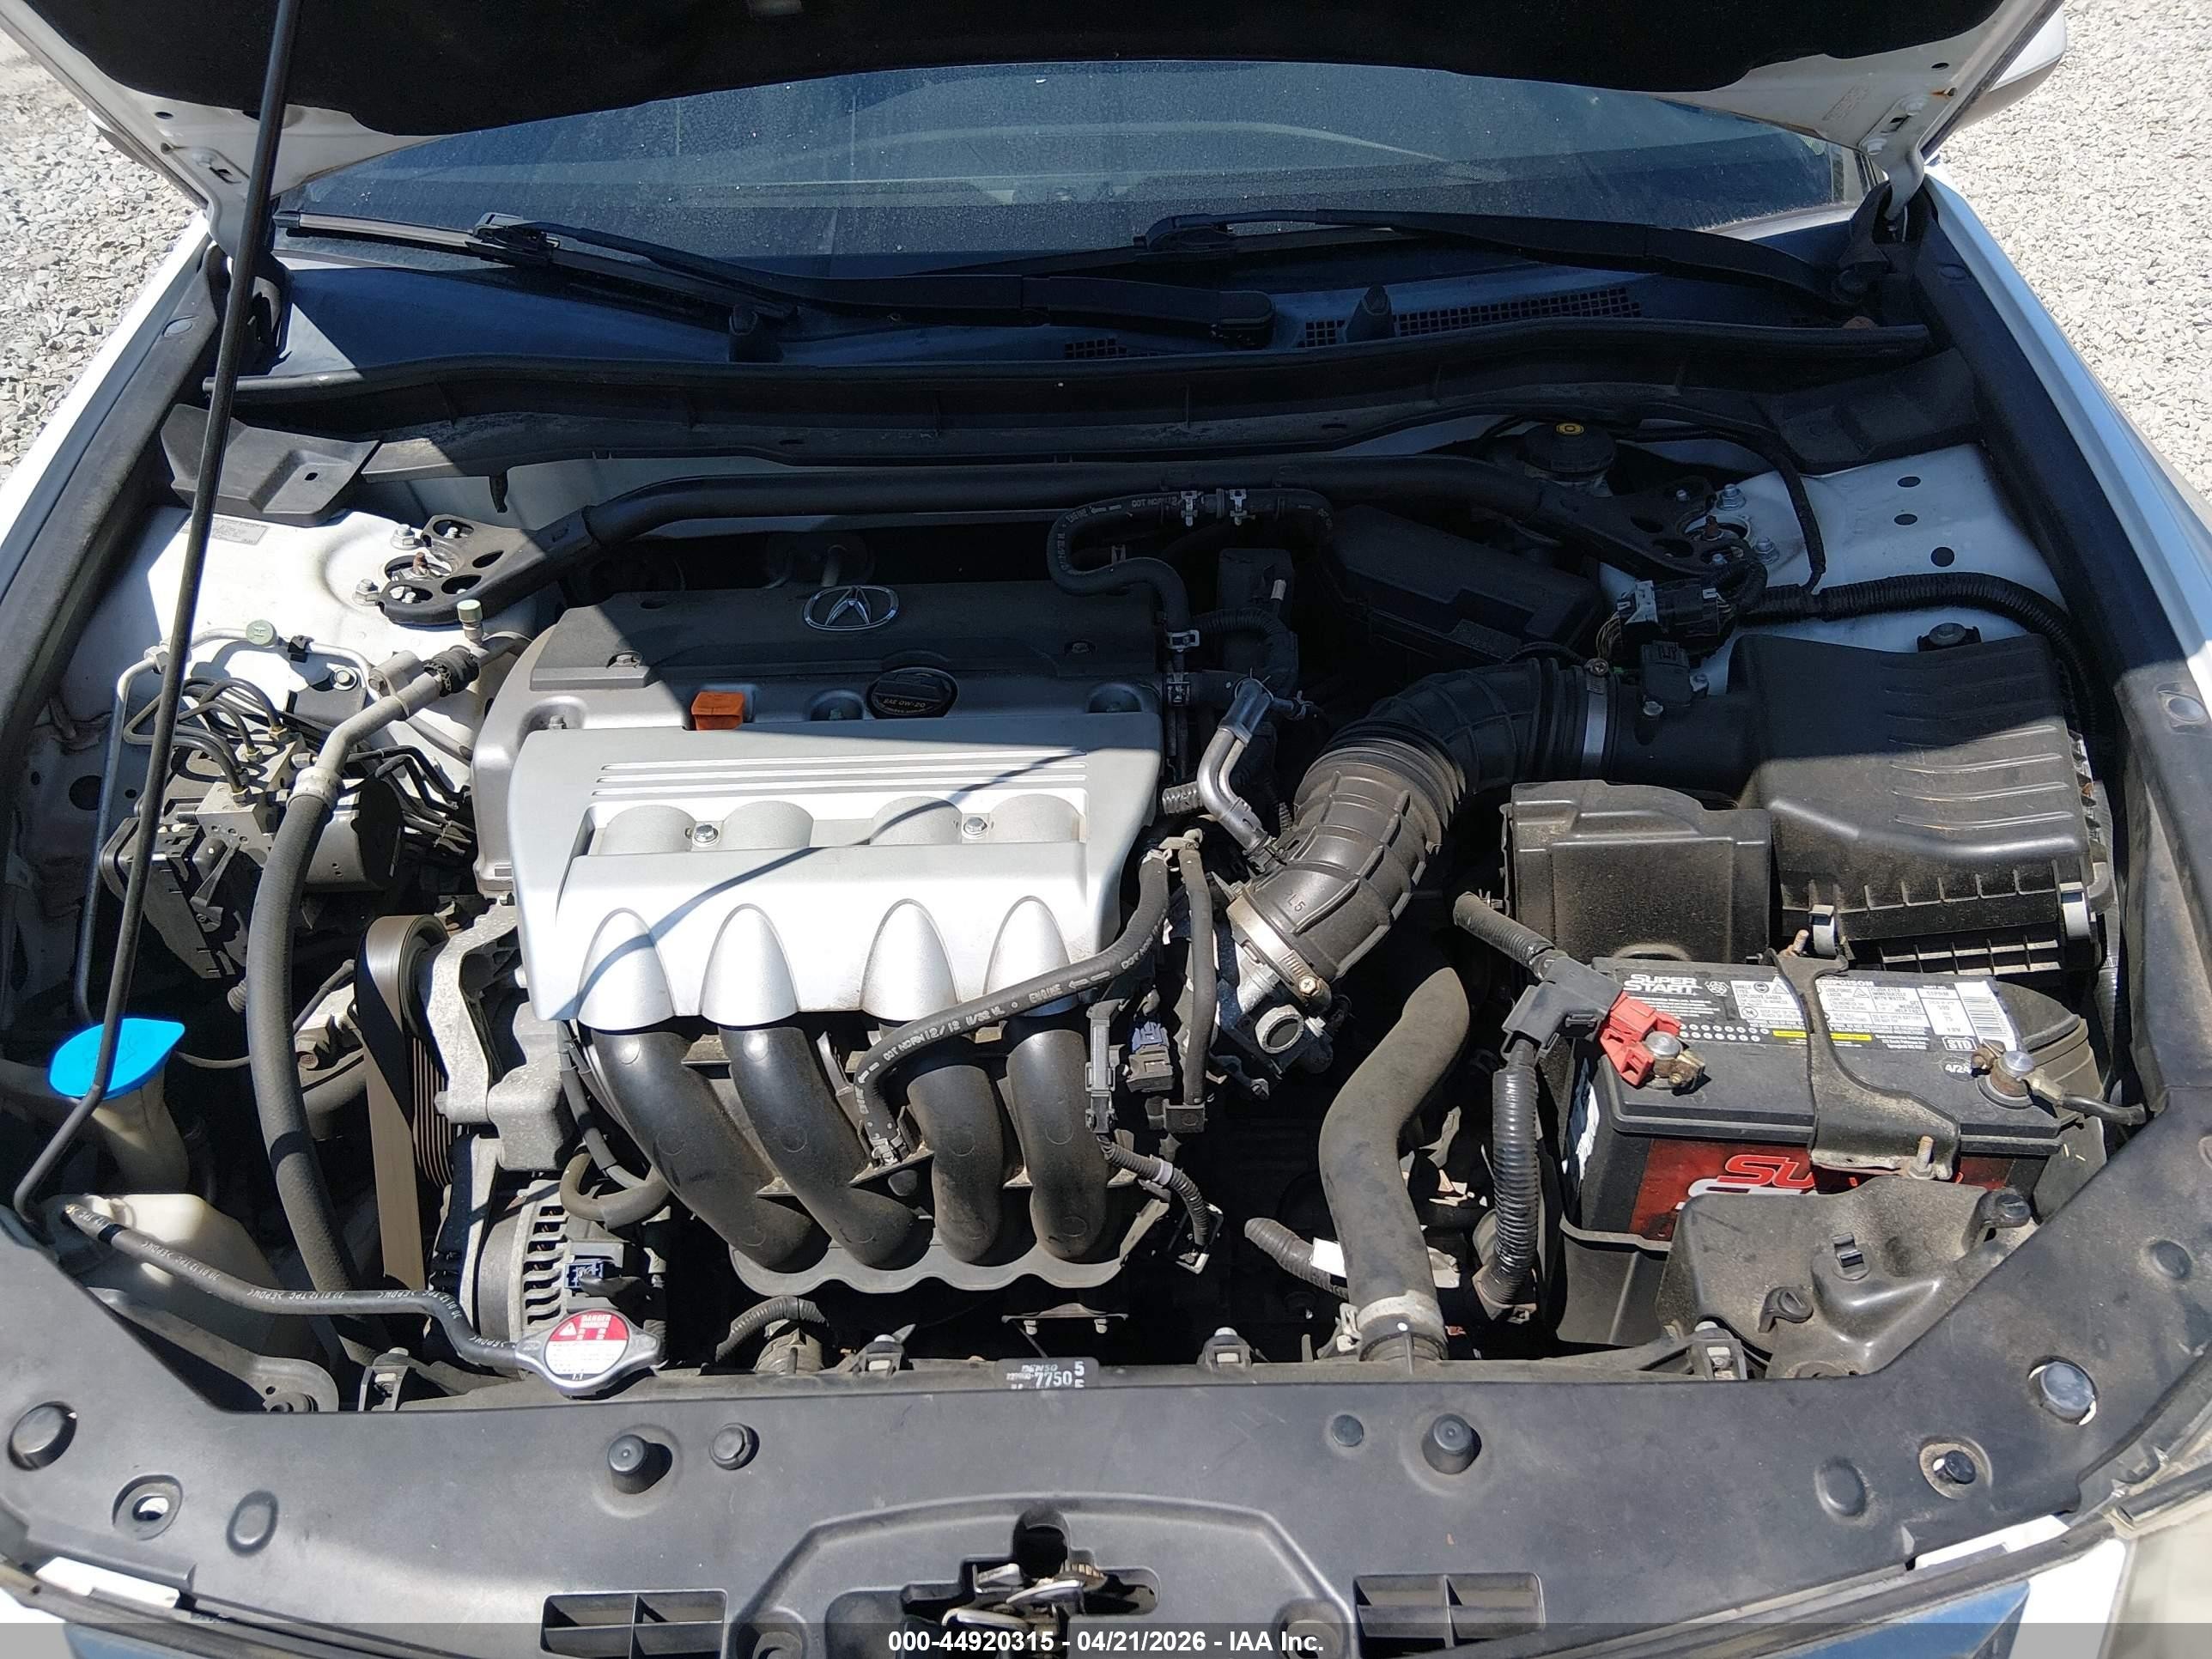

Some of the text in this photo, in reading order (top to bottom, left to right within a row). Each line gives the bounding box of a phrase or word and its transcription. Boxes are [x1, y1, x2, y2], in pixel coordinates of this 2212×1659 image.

[1630, 974, 1698, 986] SUPER
[1624, 980, 1700, 995] START
[1947, 1040, 1972, 1049] STD
[1021, 1364, 1058, 1372] DENSO
